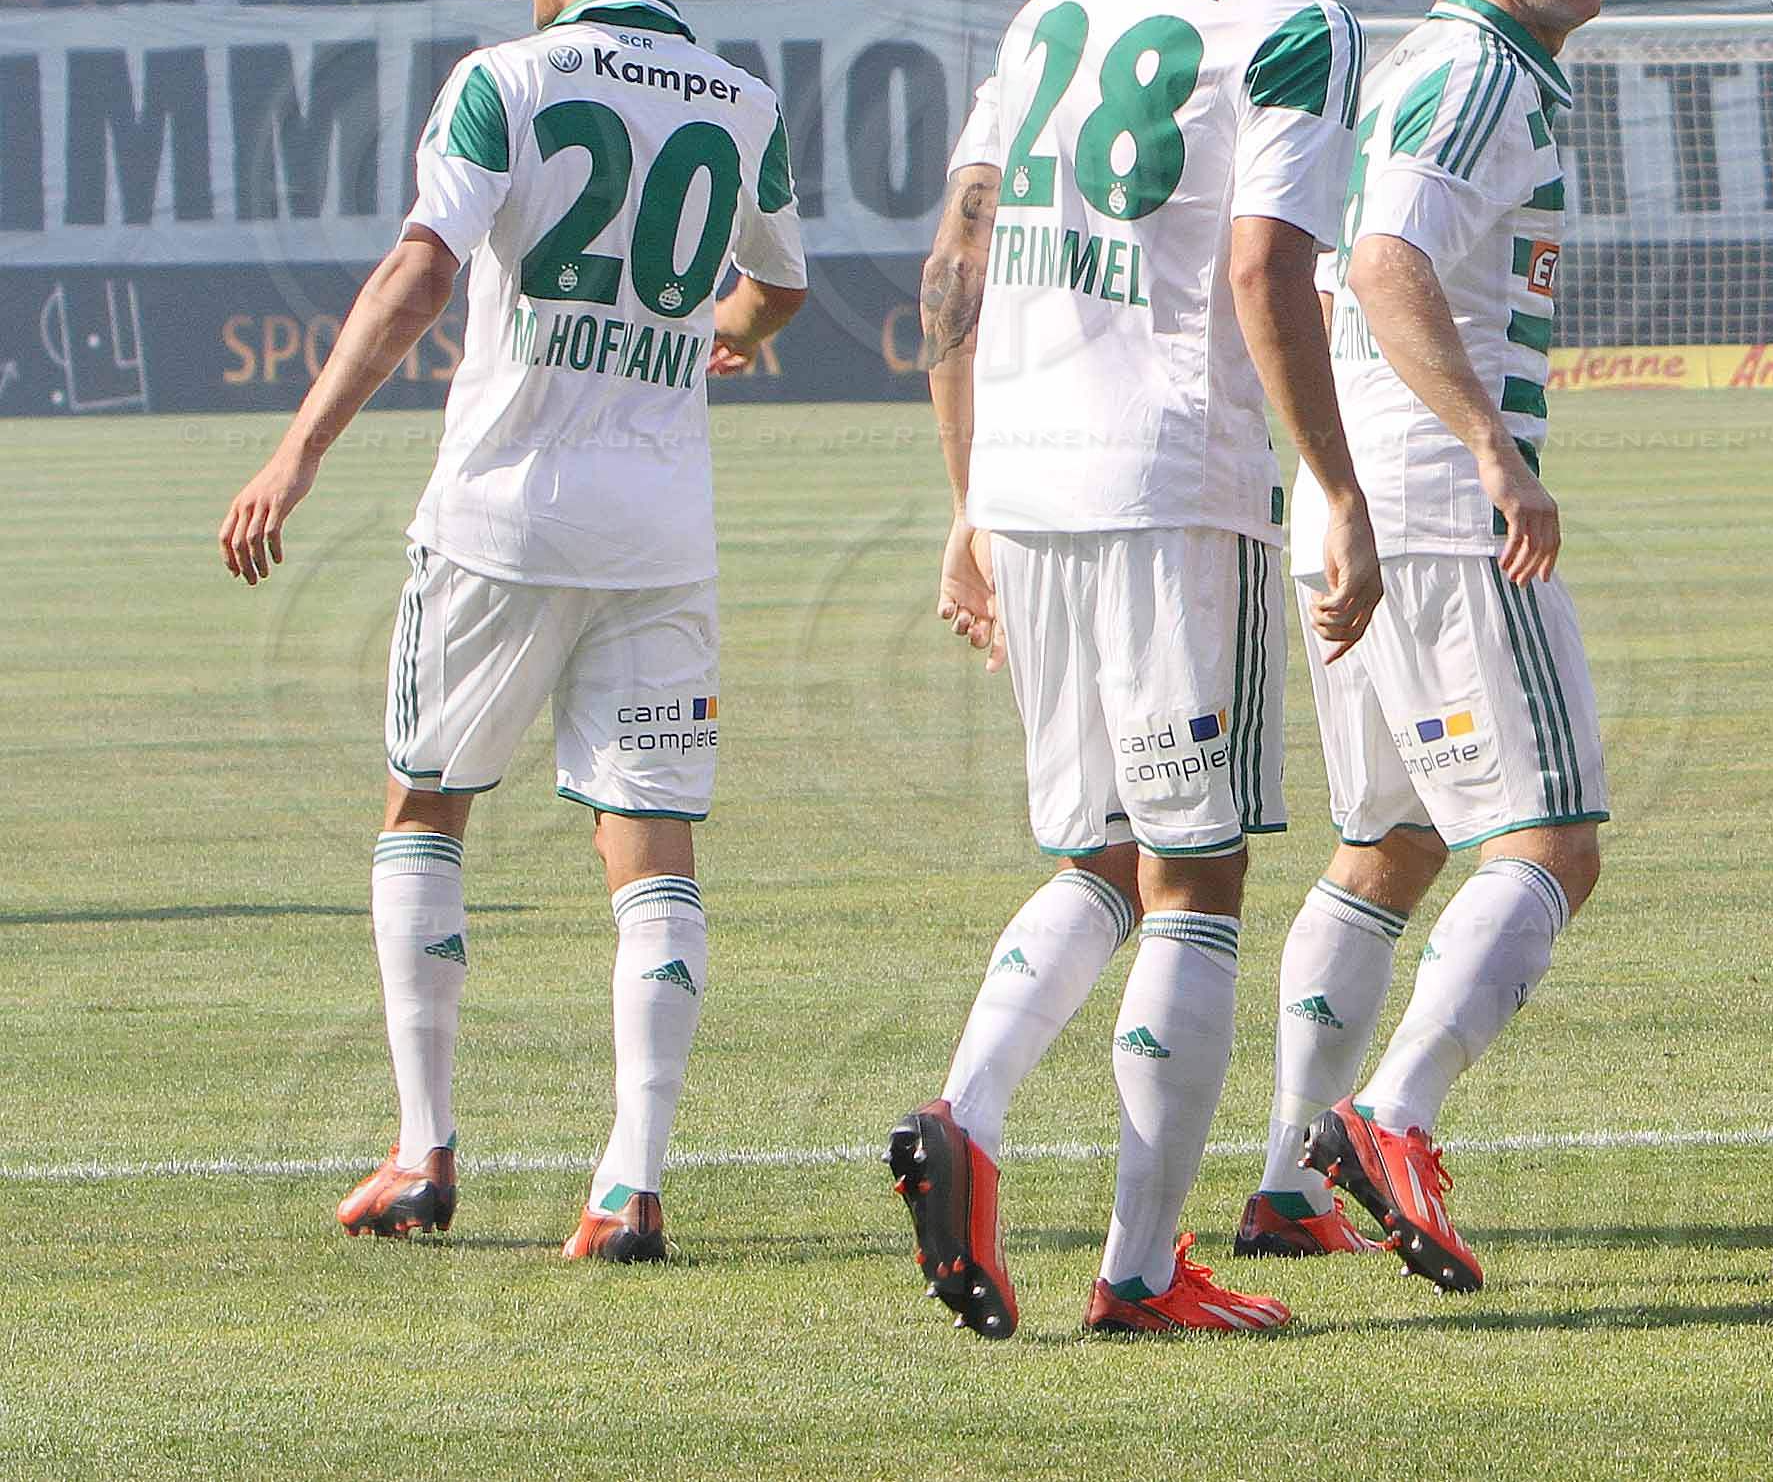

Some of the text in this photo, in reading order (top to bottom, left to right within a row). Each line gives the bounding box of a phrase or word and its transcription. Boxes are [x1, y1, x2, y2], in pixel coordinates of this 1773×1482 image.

[592, 48, 744, 105] Kamper
[997, 1, 1204, 220] 28
[520, 98, 742, 319] 20
[617, 698, 681, 724] card
[619, 724, 719, 756] complete
[1120, 723, 1176, 755] card
